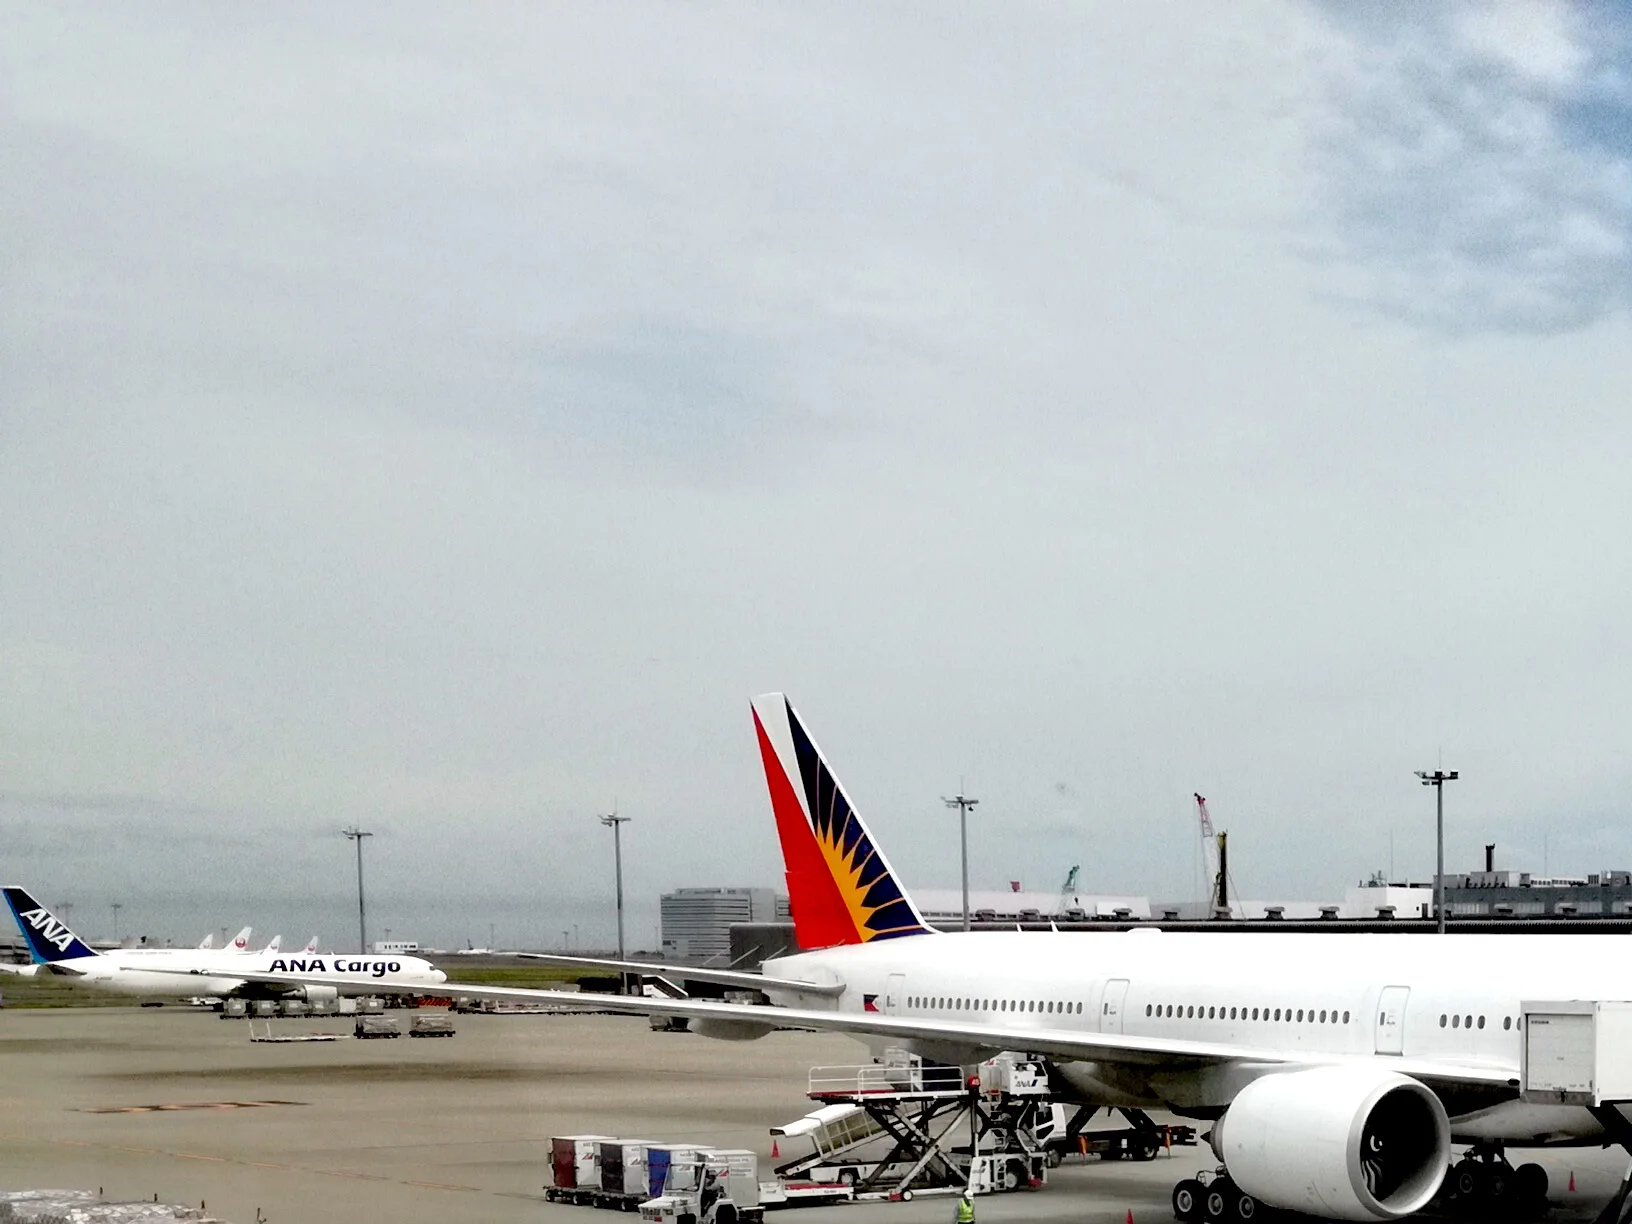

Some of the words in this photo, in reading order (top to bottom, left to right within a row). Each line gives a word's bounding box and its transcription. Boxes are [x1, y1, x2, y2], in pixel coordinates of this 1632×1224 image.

[19, 907, 76, 953] ANA
[268, 959, 327, 972] ANA
[333, 959, 401, 978] Cargo
